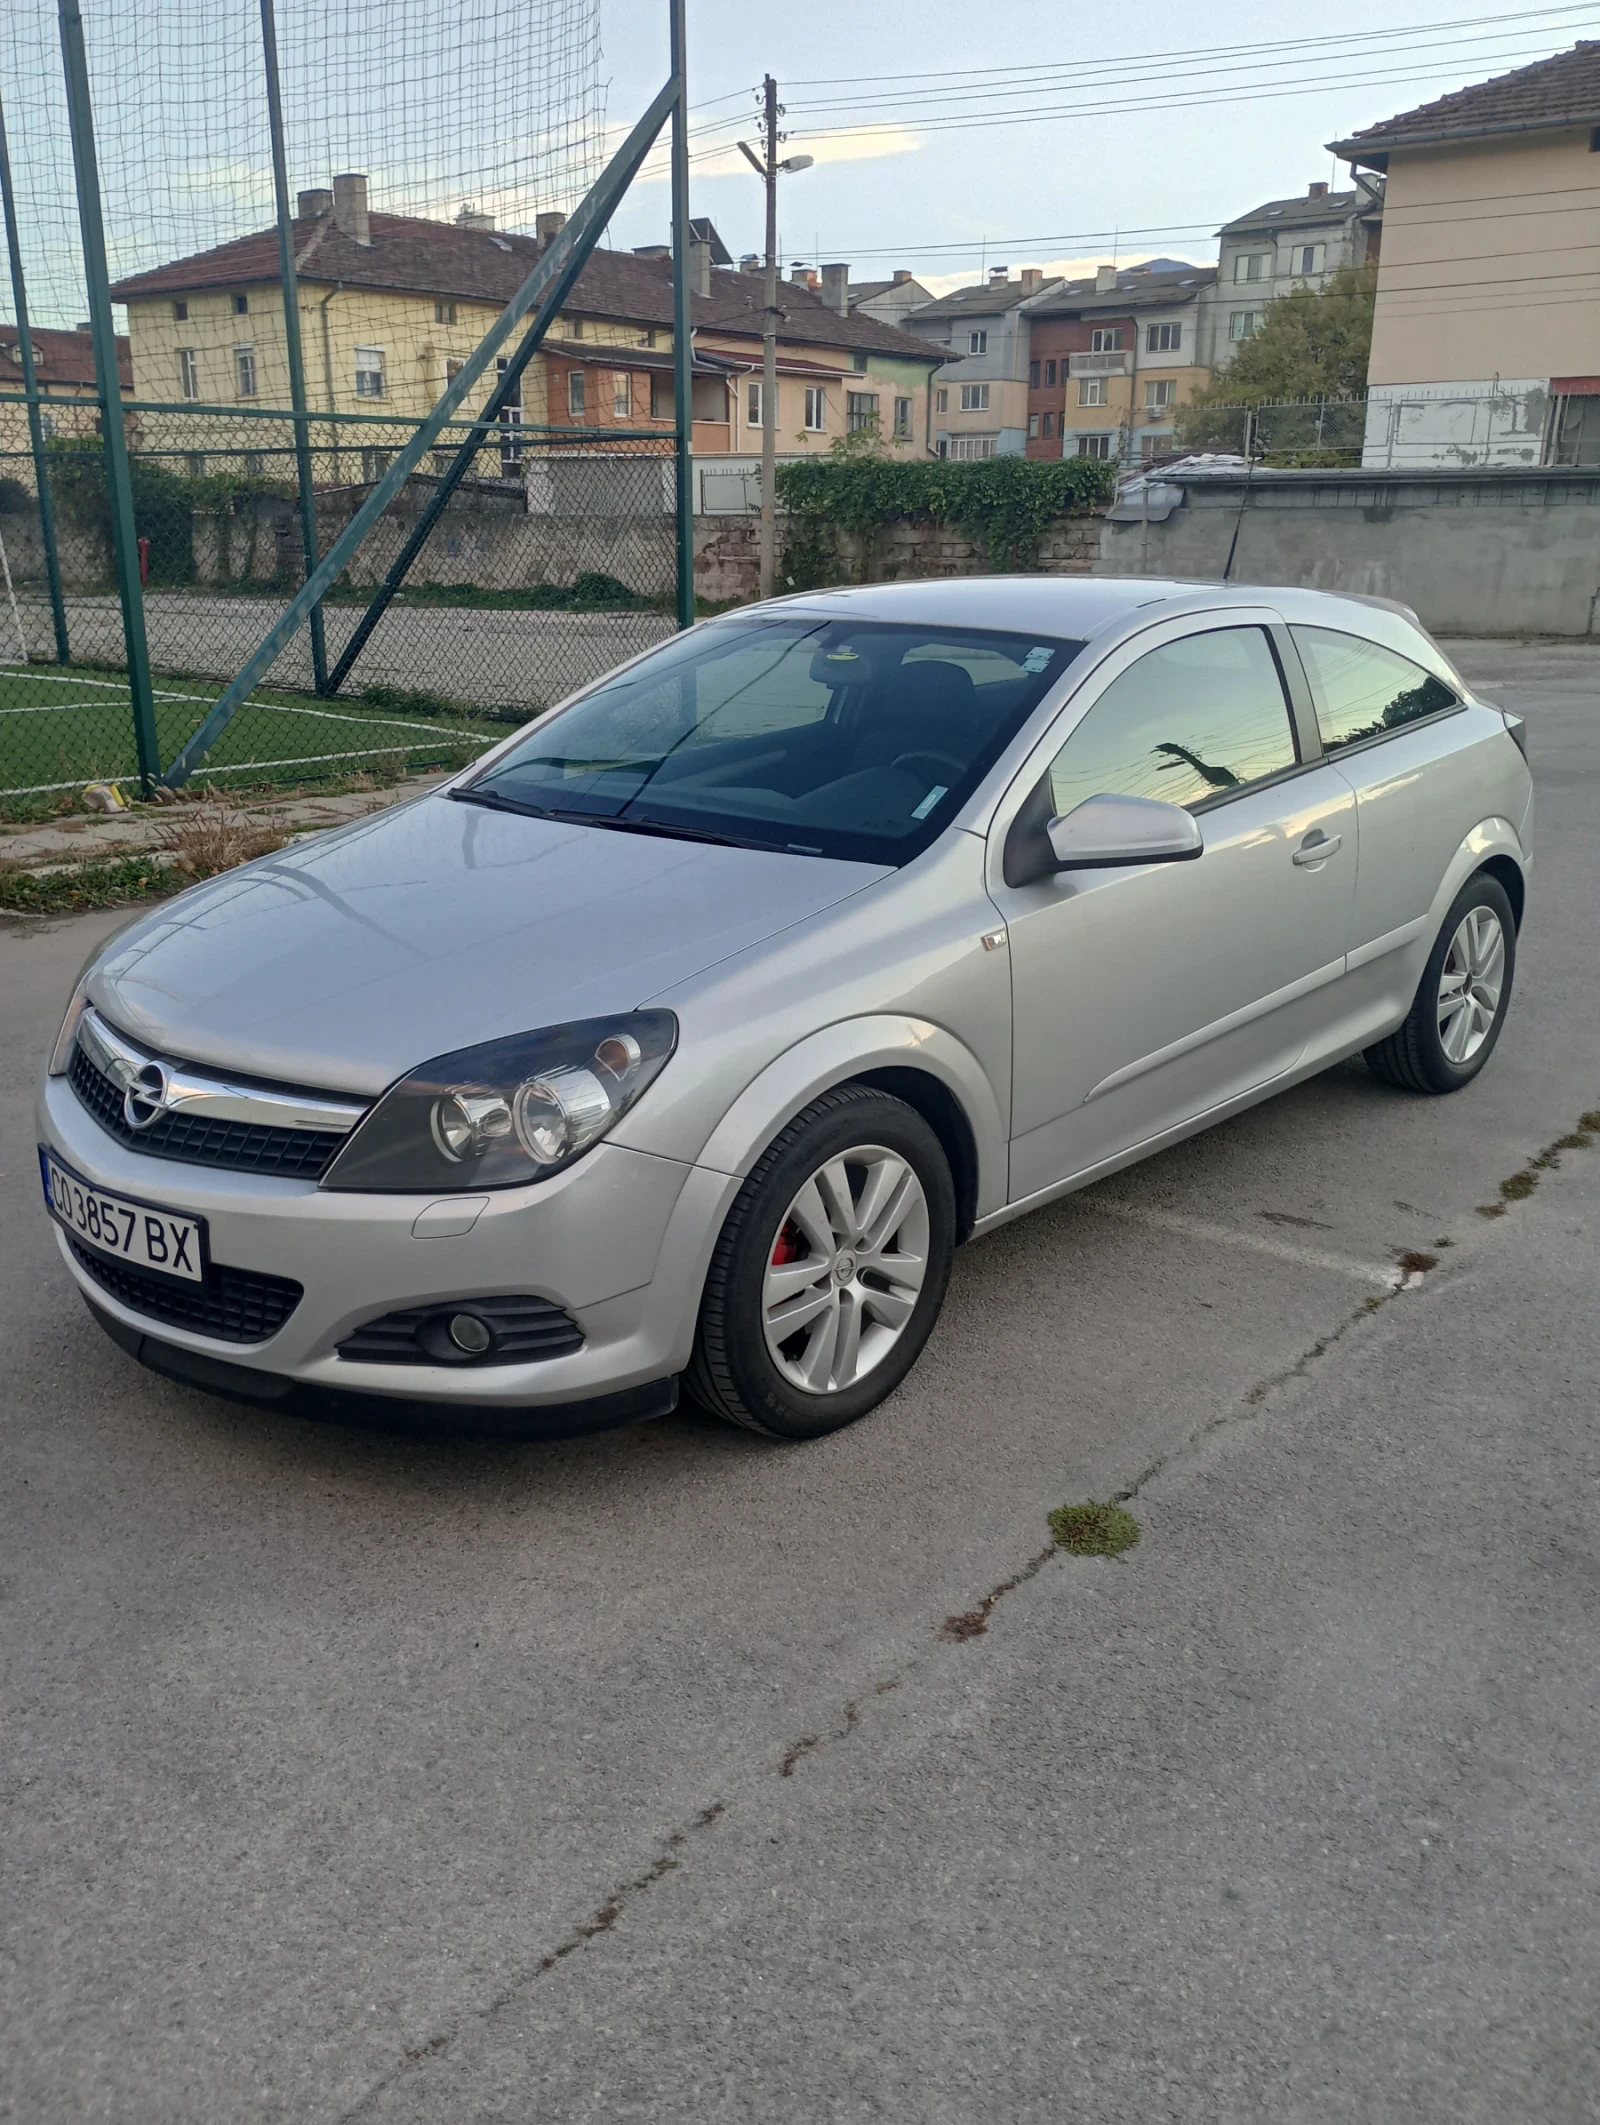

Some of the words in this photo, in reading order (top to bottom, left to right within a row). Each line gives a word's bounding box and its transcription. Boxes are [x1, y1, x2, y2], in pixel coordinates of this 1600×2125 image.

[51, 1167, 72, 1219] CO
[74, 1187, 136, 1252] 3857
[144, 1216, 193, 1273] BX
